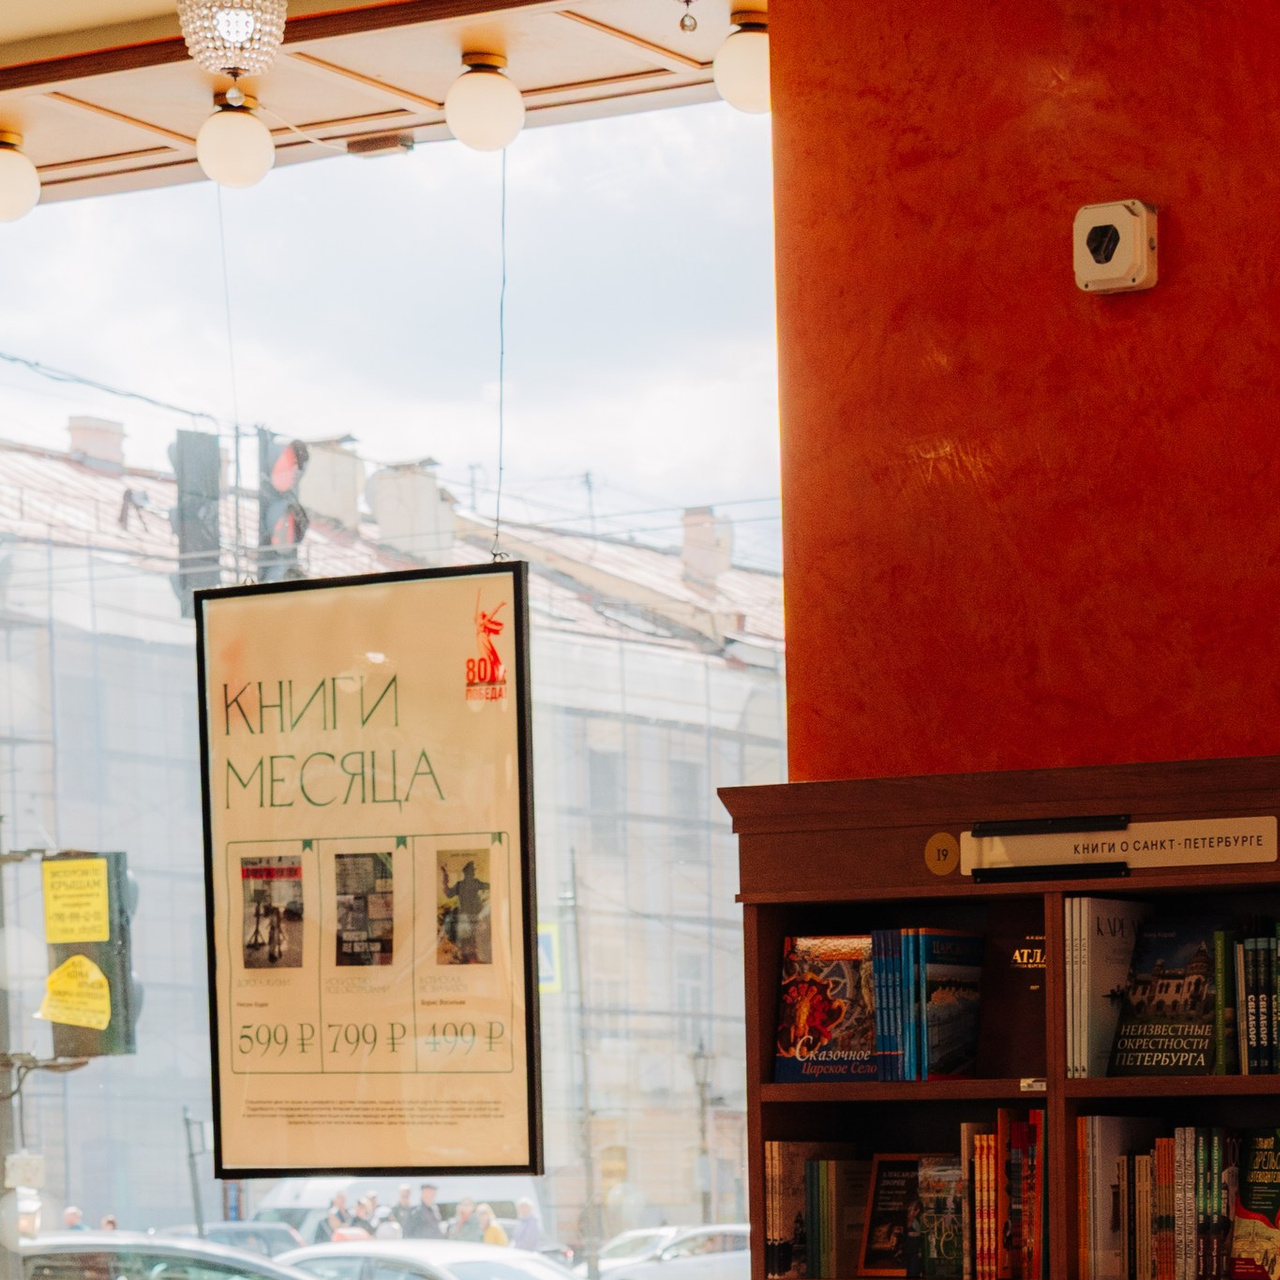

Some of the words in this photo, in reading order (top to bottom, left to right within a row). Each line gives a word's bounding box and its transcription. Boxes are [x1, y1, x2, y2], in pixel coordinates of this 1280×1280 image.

[466, 658, 487, 683] 80
[223, 674, 399, 735] КНИГИ
[225, 747, 446, 813] МЕСЯЦА
[1073, 841, 1116, 855] КНИГИ
[1120, 839, 1129, 852] О
[1133, 833, 1264, 852] САНКТ-ПЕТЕРБУРГЕ
[238, 1023, 288, 1055] 599
[327, 1023, 378, 1056] 799
[424, 1020, 476, 1055] 499
[1120, 1024, 1213, 1037] НЕИЗВЕСТНЫЕ
[795, 1035, 872, 1062] Сказочное
[1116, 1038, 1210, 1051] ОКРЕСТНОСТИ
[850, 1061, 877, 1075] Село
[1115, 1052, 1206, 1067] ПЕТЕРБУРГА
